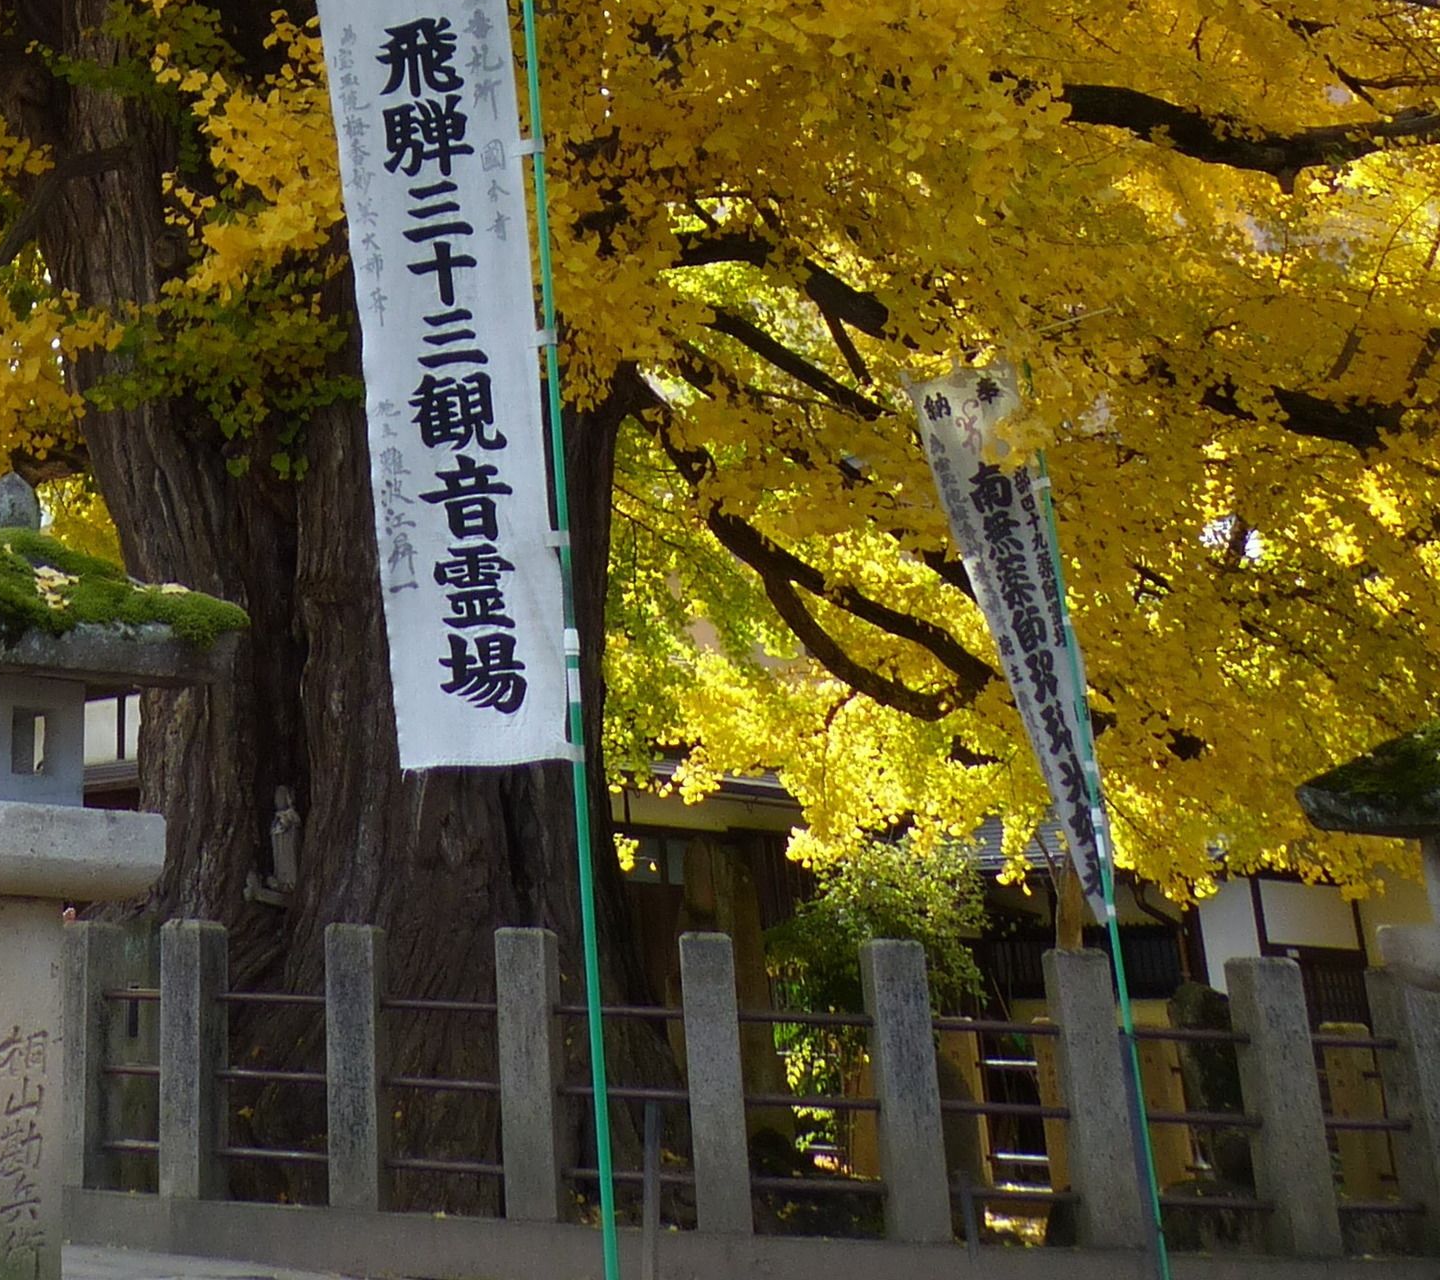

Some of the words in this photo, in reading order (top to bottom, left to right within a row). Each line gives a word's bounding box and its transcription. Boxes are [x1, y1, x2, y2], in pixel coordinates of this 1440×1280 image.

[376, 16, 528, 714] 飛騨三十三観音霊場
